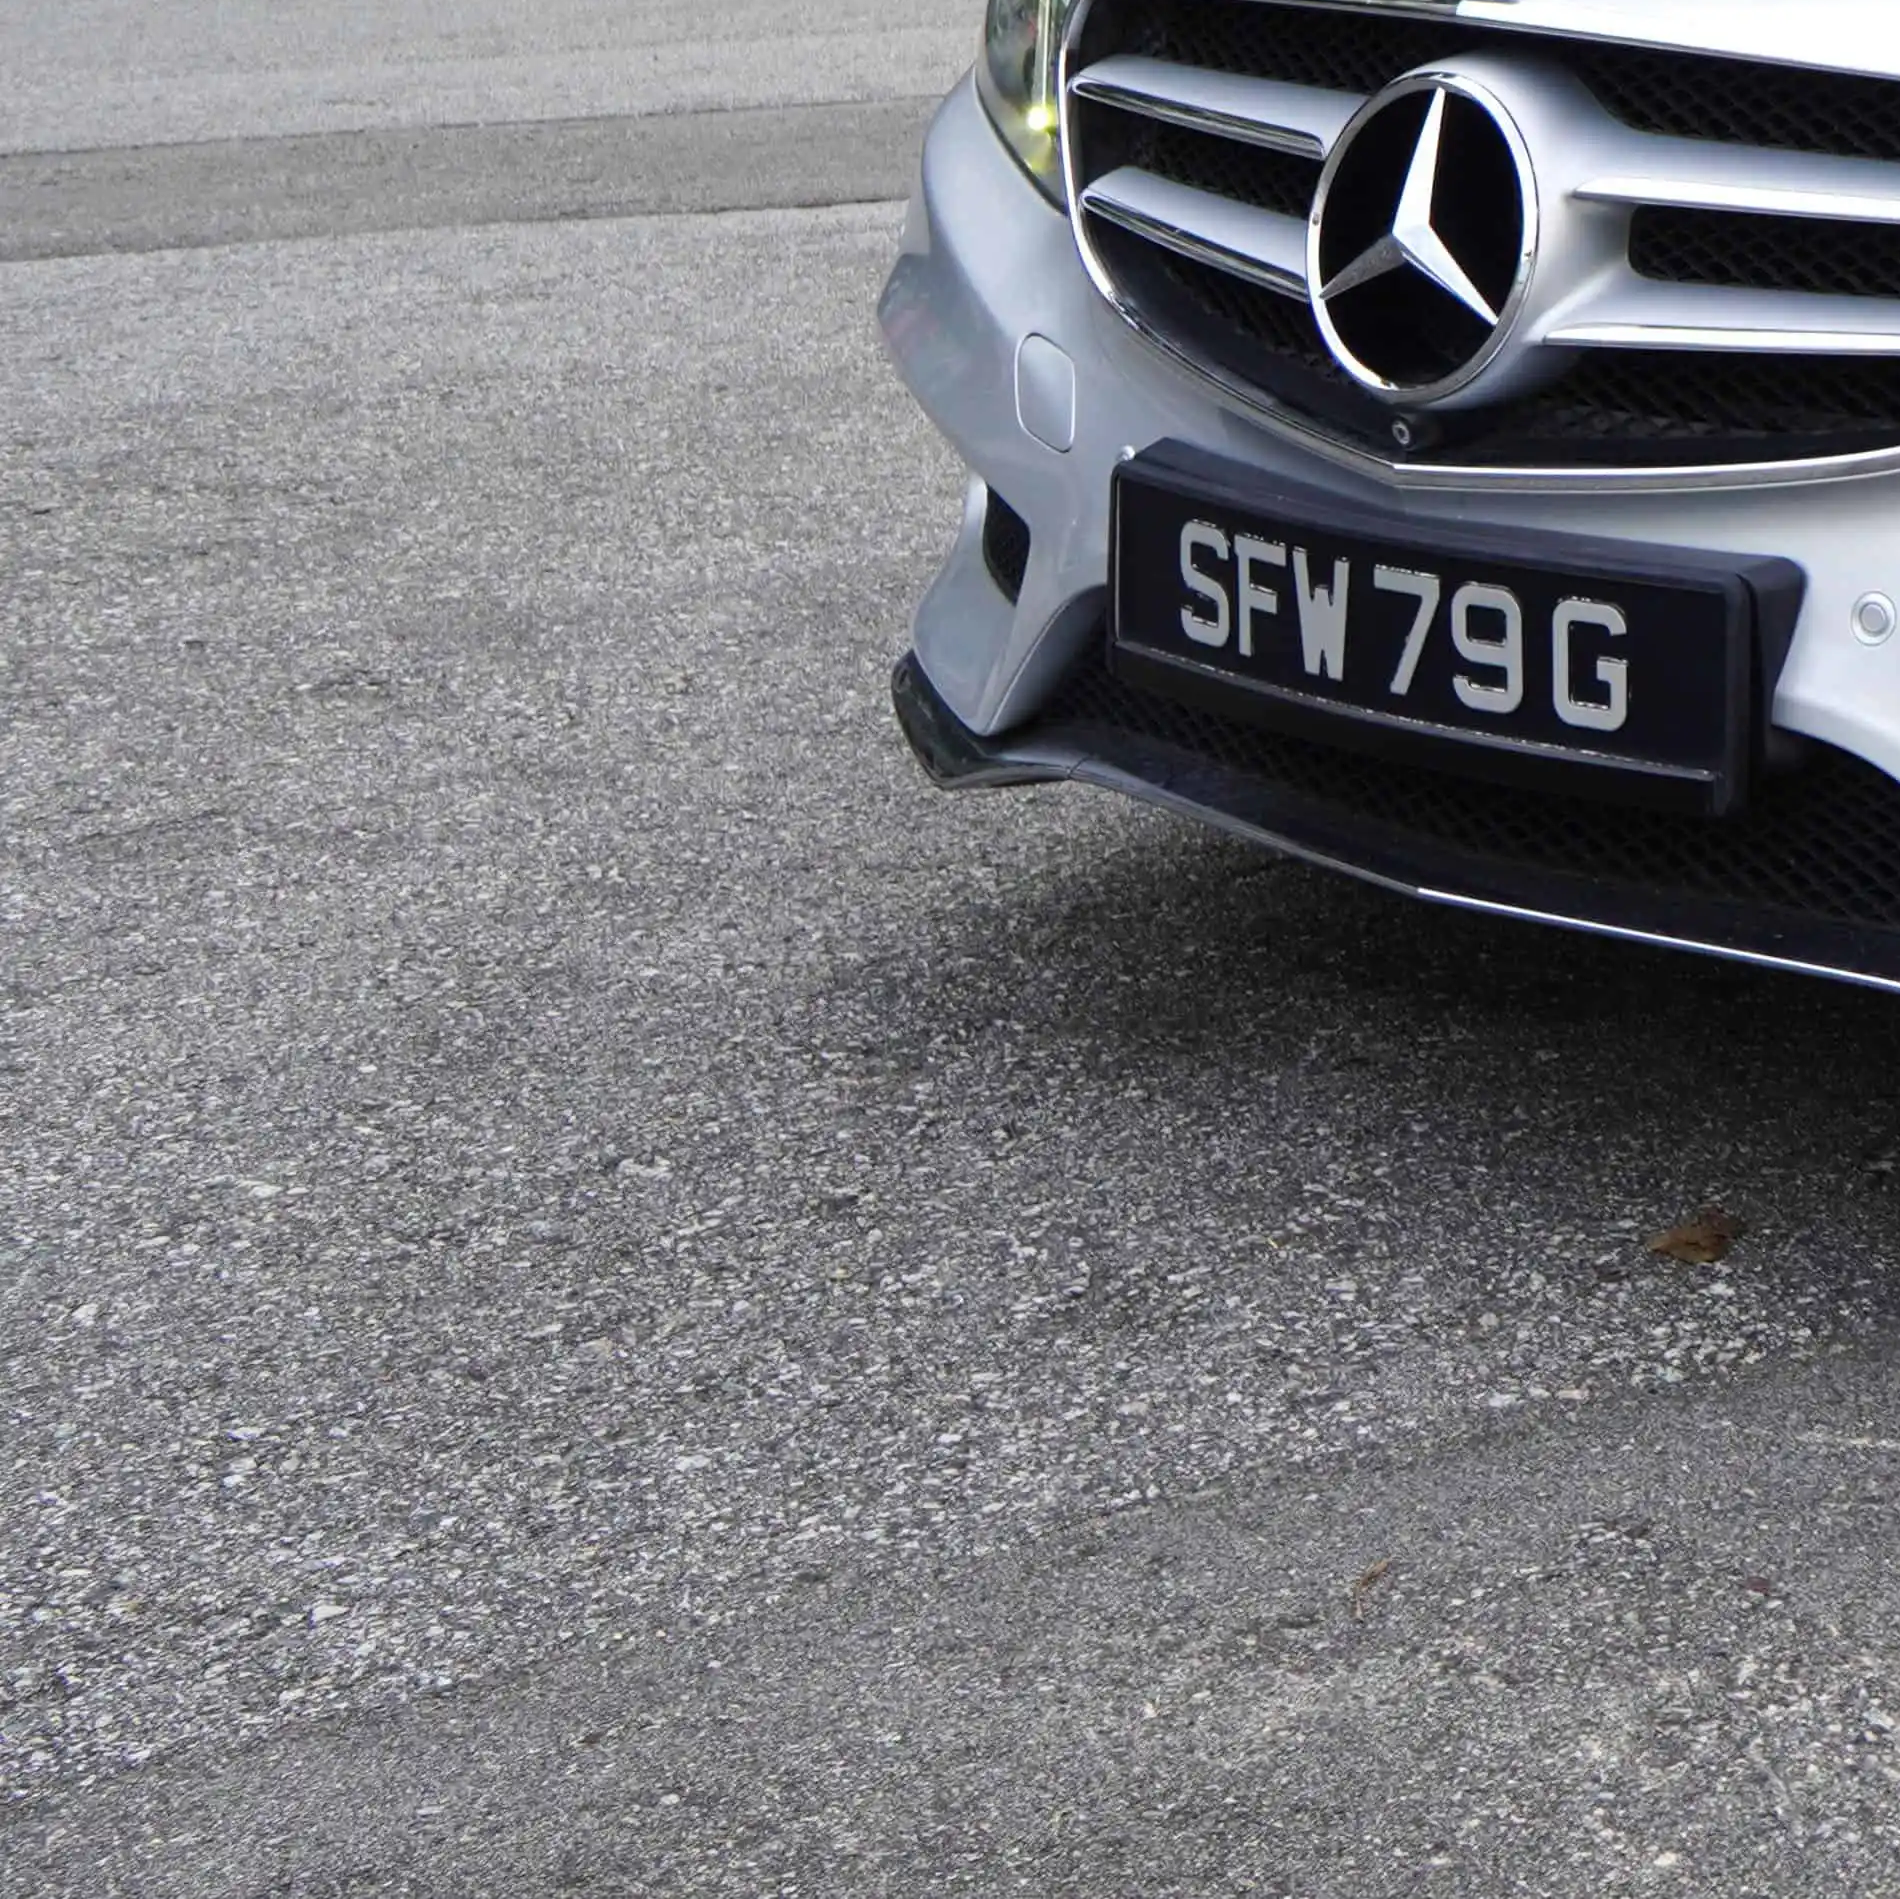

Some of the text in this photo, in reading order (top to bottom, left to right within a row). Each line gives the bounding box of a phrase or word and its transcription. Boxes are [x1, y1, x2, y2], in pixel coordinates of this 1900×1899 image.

[1180, 518, 1629, 732] SFW 79 G
